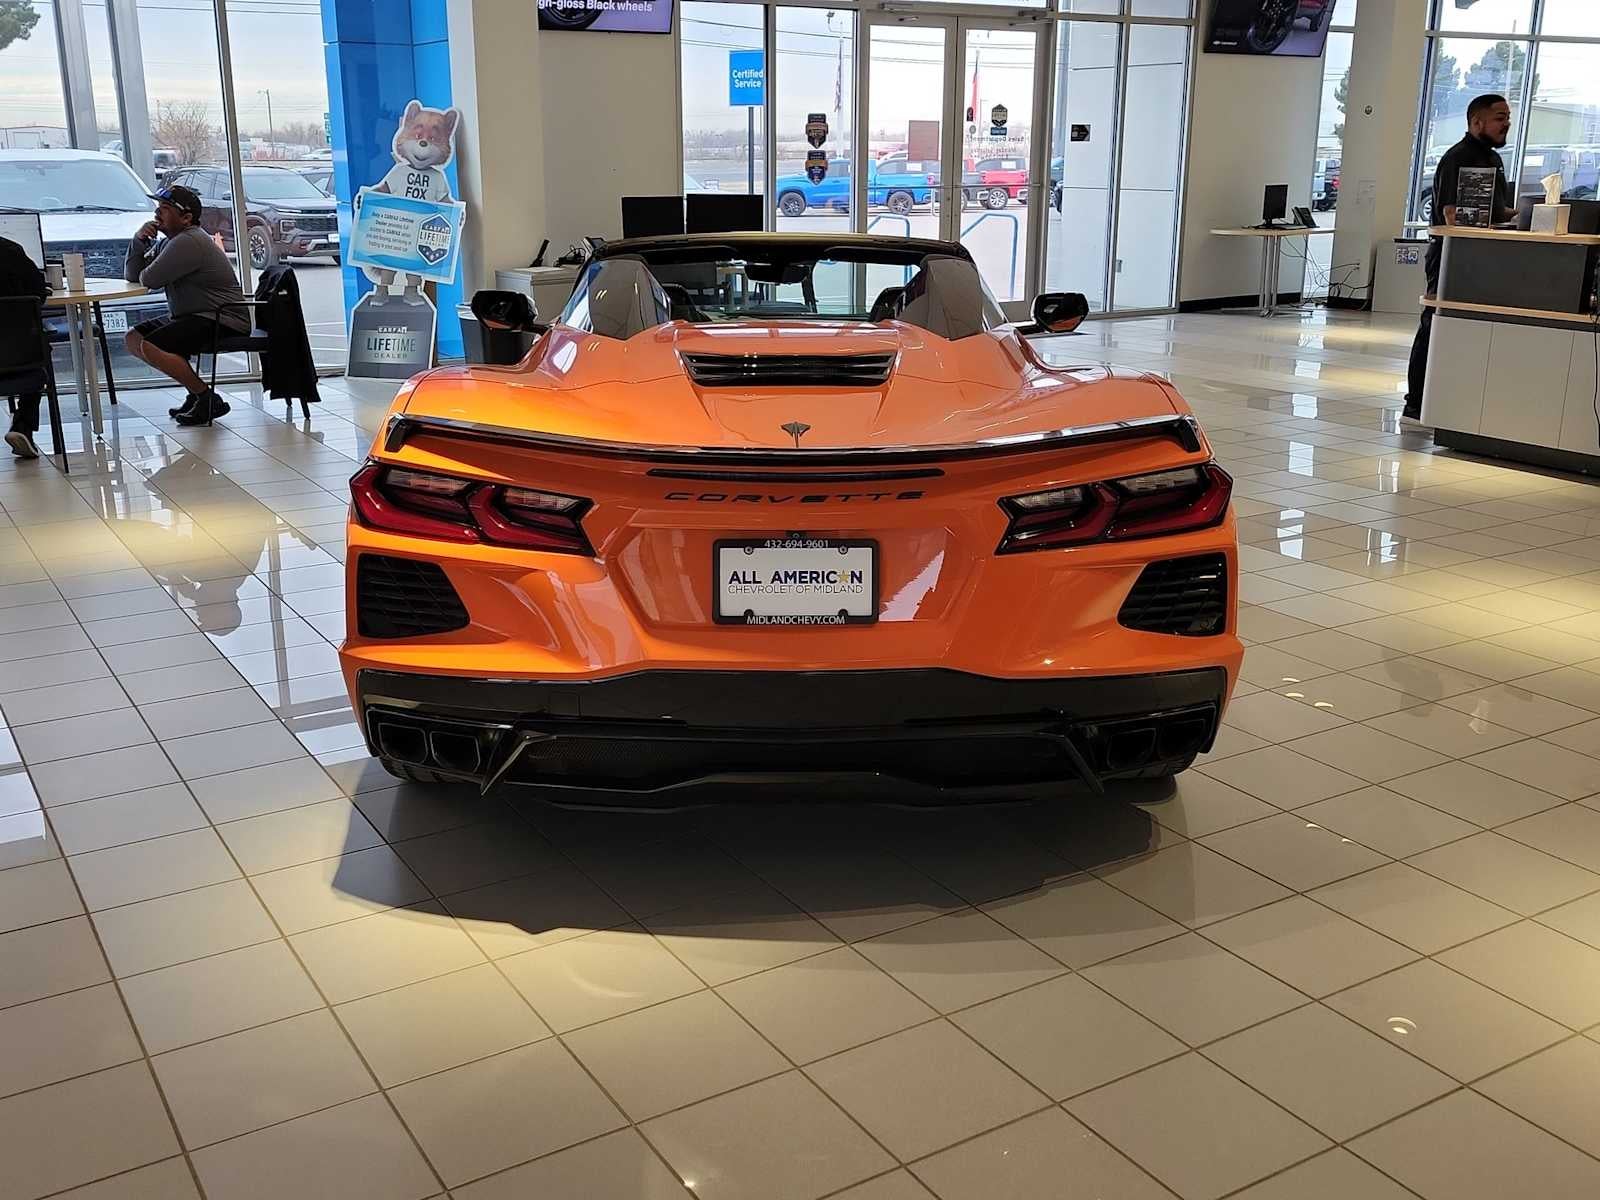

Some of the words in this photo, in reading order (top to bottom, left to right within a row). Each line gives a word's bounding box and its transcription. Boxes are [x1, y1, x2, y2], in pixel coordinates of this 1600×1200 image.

[587, 0, 616, 10] Black
[617, 1, 653, 12] wheels
[732, 69, 764, 79] Certified
[734, 79, 762, 88] Service
[407, 172, 430, 187] CAR
[405, 186, 427, 200] FOX
[367, 337, 417, 352] LIFETIME
[664, 490, 927, 503] CORVETTE
[764, 539, 829, 549] 432-694-9601
[728, 570, 762, 585] ALL
[728, 585, 792, 594] CHEVROLET
[795, 585, 811, 594] OF
[814, 585, 863, 594] MIDLAND
[746, 615, 846, 625] MIDLANDCHEVY.COM
